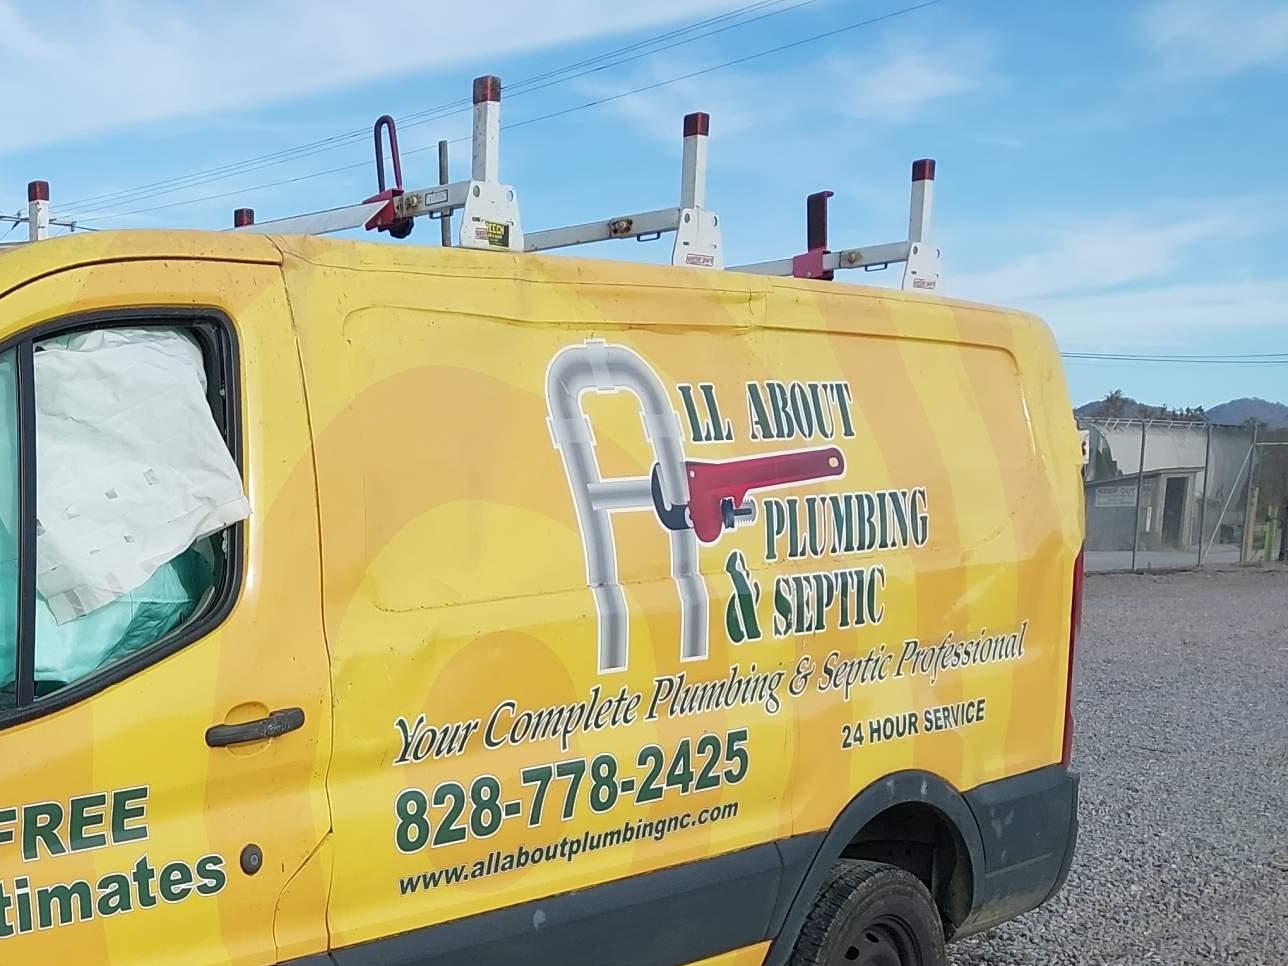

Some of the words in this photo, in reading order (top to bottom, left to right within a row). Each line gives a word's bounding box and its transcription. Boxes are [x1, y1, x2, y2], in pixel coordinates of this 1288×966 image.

[747, 380, 856, 441] ABOUT
[763, 488, 929, 562] PLUMBING
[724, 549, 763, 645] &
[772, 566, 887, 639] SEPTIC
[393, 713, 481, 766] Your
[483, 684, 642, 752] Complete
[645, 664, 783, 717] Plumbing
[788, 655, 817, 698] &
[817, 643, 893, 702] Septic
[893, 621, 1028, 683] Professional
[840, 722, 864, 750] 24
[868, 712, 920, 745] HOUR
[923, 699, 986, 737] SERVICE
[394, 729, 750, 856] 828-778-2425
[397, 799, 740, 896] www.allaboutplumbingnc.com
